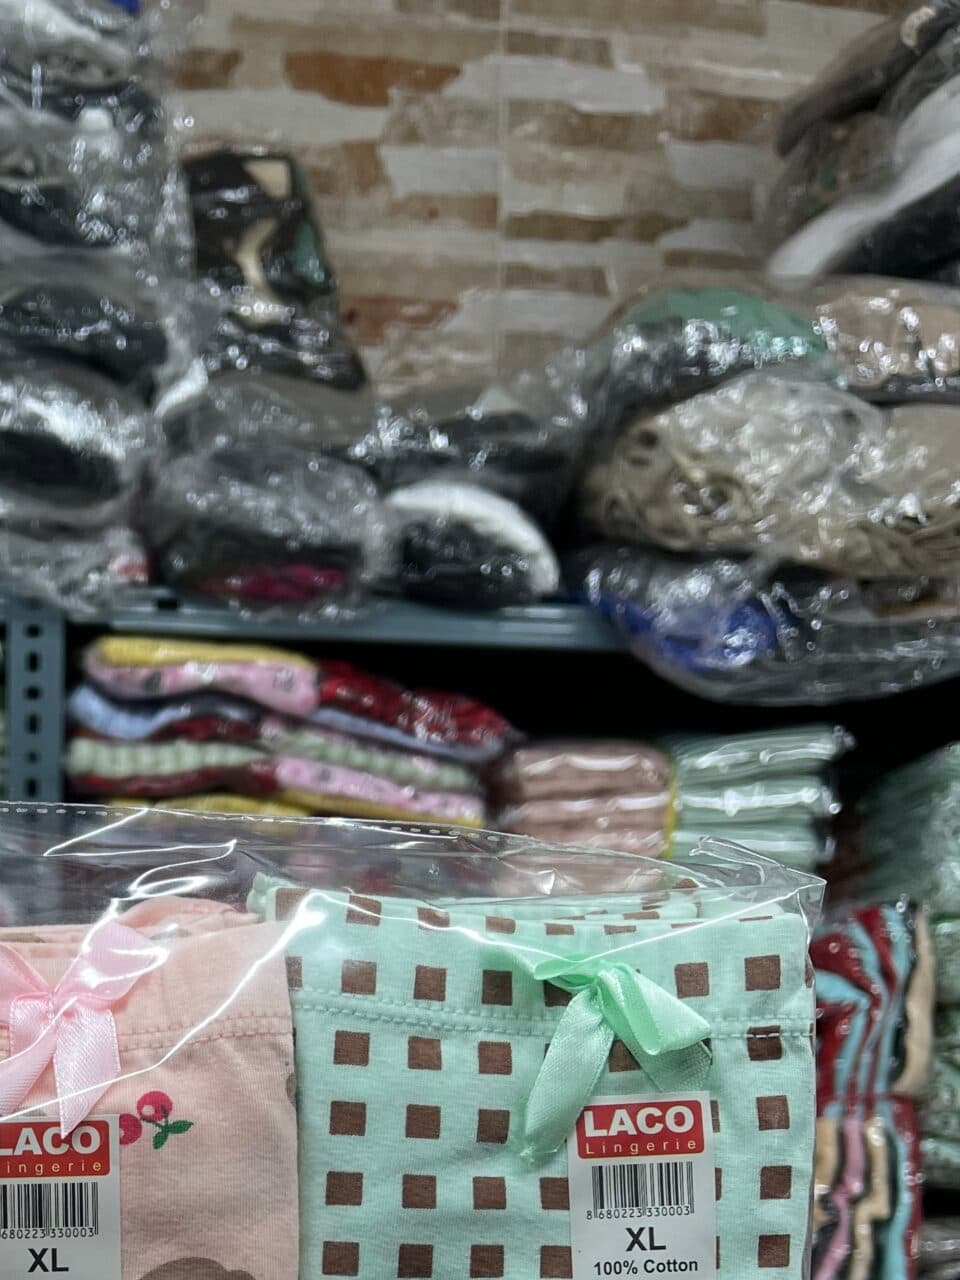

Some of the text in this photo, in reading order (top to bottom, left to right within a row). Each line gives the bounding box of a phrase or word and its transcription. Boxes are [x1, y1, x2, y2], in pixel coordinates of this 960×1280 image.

[583, 1105, 695, 1137] LACO
[586, 1139, 696, 1154] Lingerie
[625, 1227, 667, 1252] XL
[27, 1247, 69, 1273] XL
[594, 1259, 698, 1276] 100% Cotton
